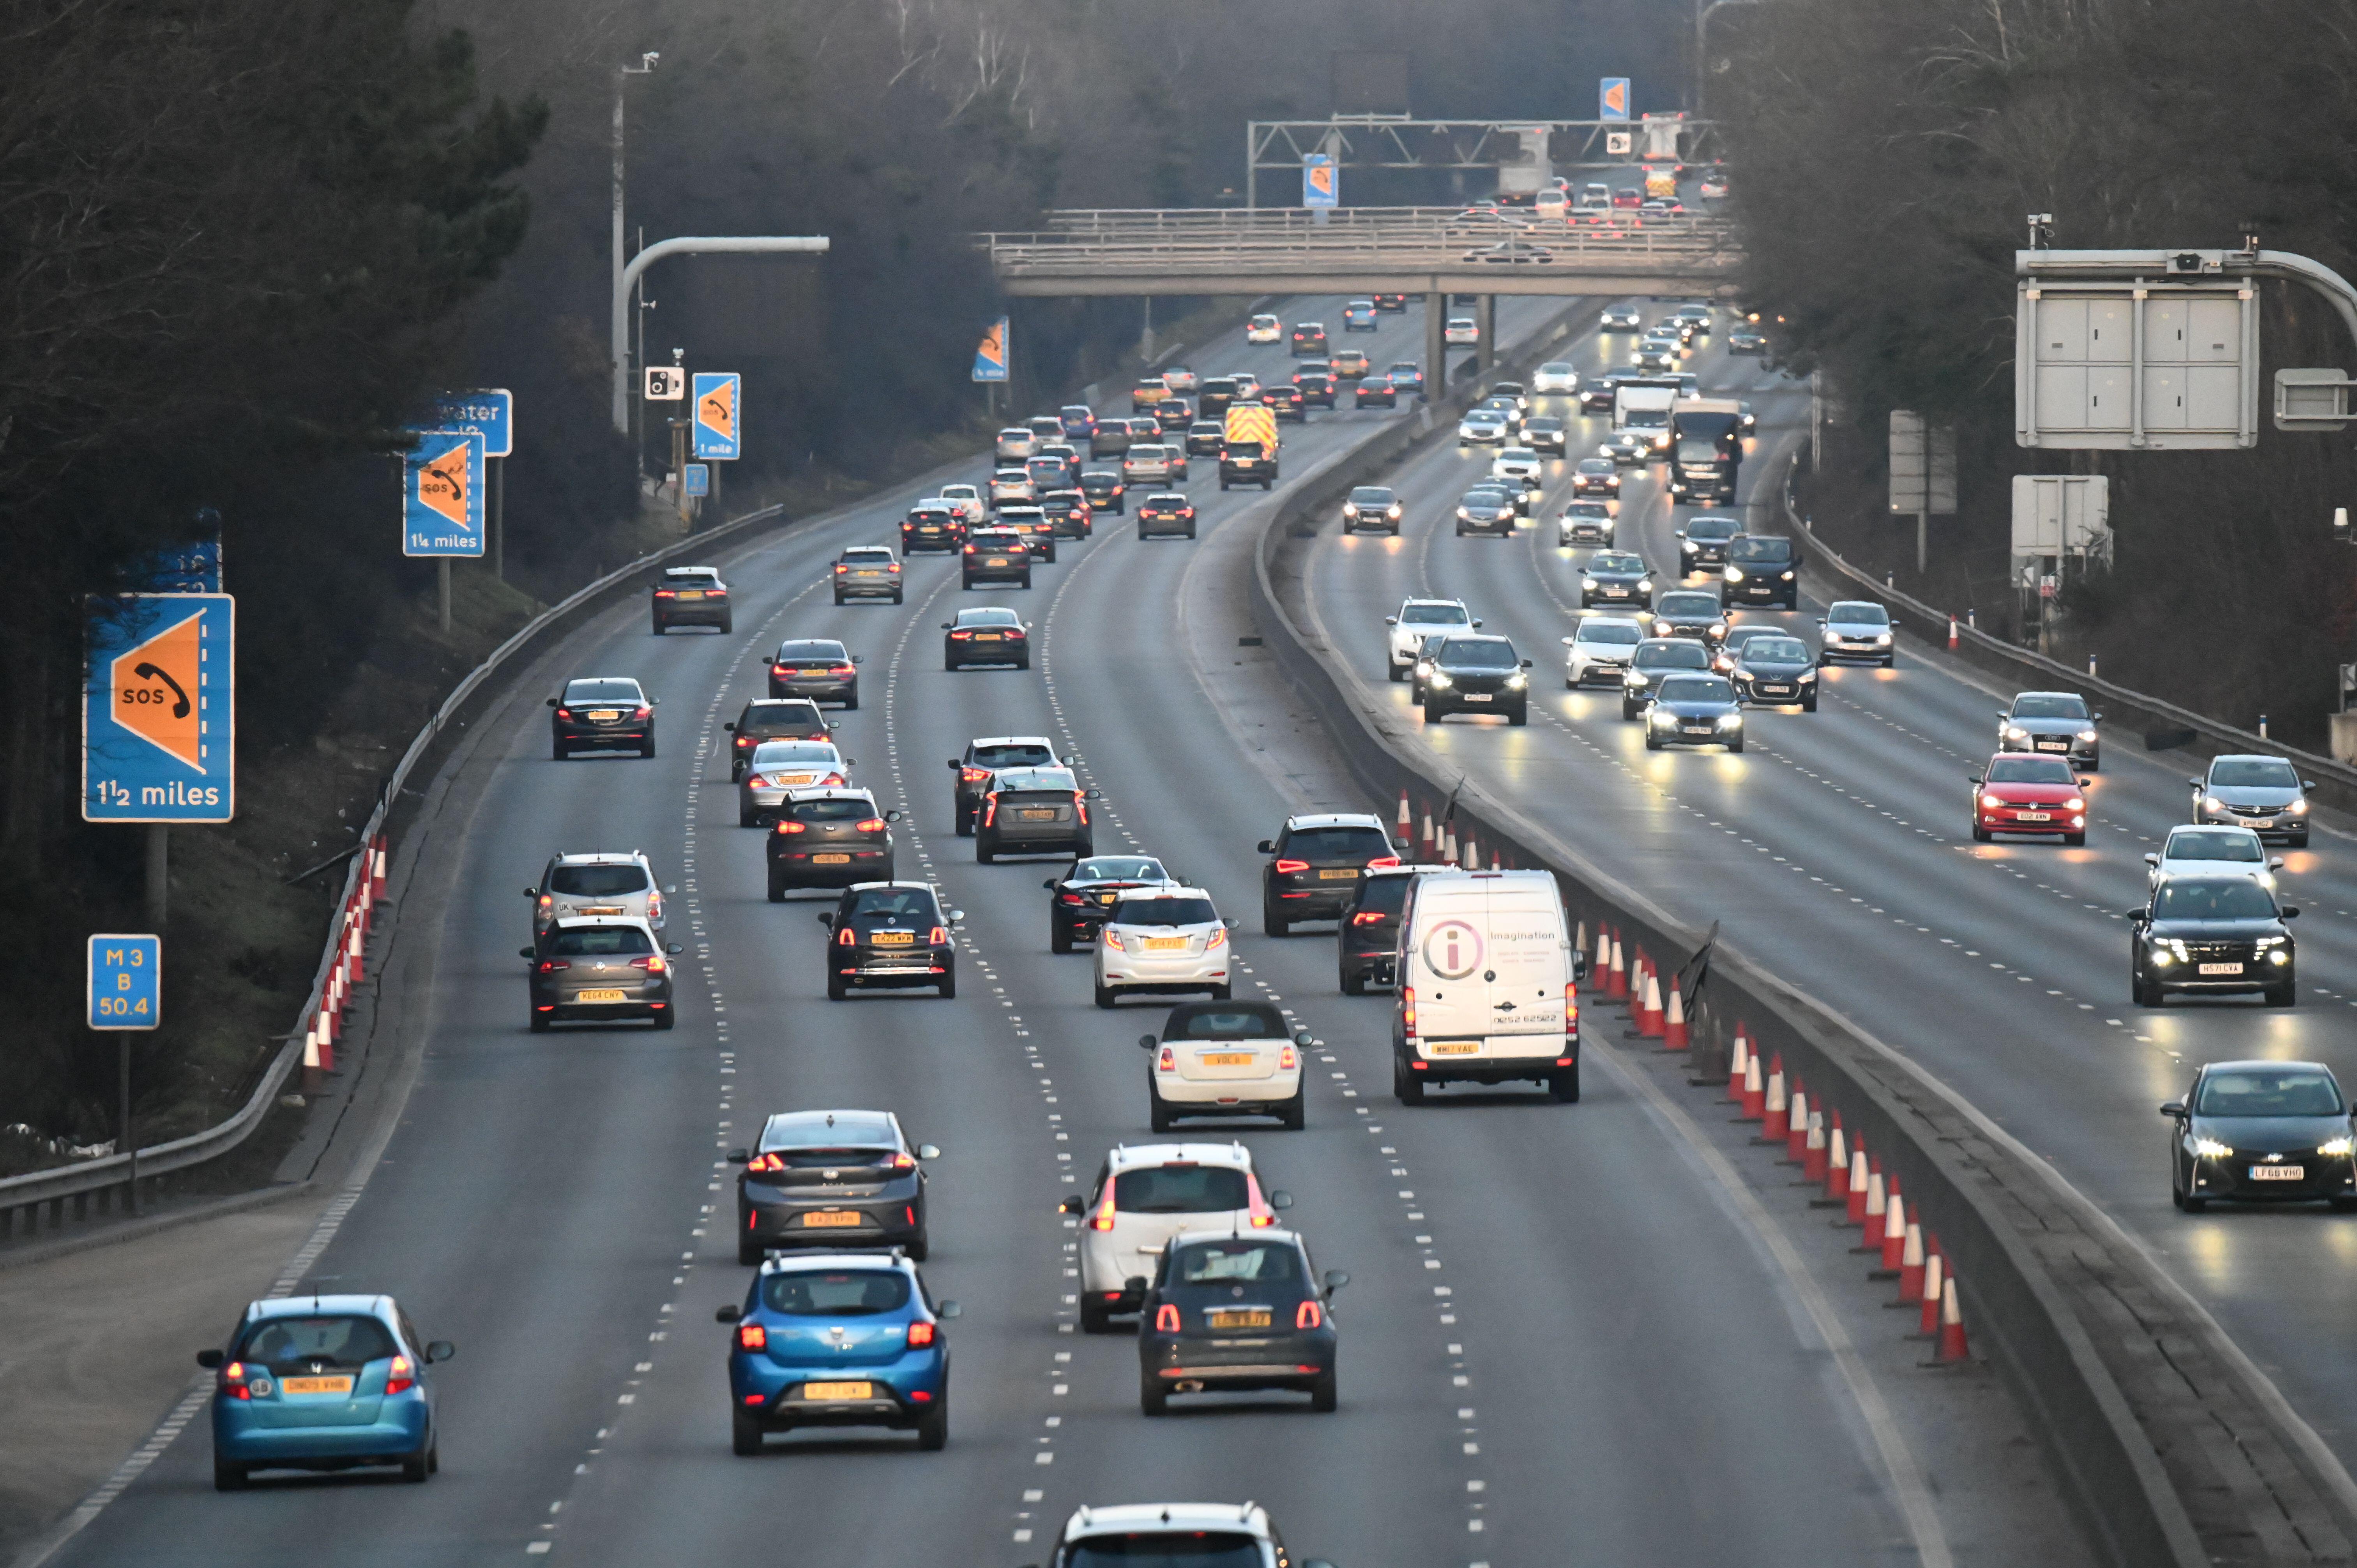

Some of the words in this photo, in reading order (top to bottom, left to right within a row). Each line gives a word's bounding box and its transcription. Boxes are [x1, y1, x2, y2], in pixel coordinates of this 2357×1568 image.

[700, 443, 705, 453] 1
[708, 443, 733, 453] mile
[435, 534, 477, 547] miles
[122, 689, 164, 704] SOS
[142, 780, 219, 805] miles
[107, 949, 123, 966] M
[131, 948, 143, 966] 3
[118, 973, 131, 991] B
[100, 998, 148, 1015] 50.4
